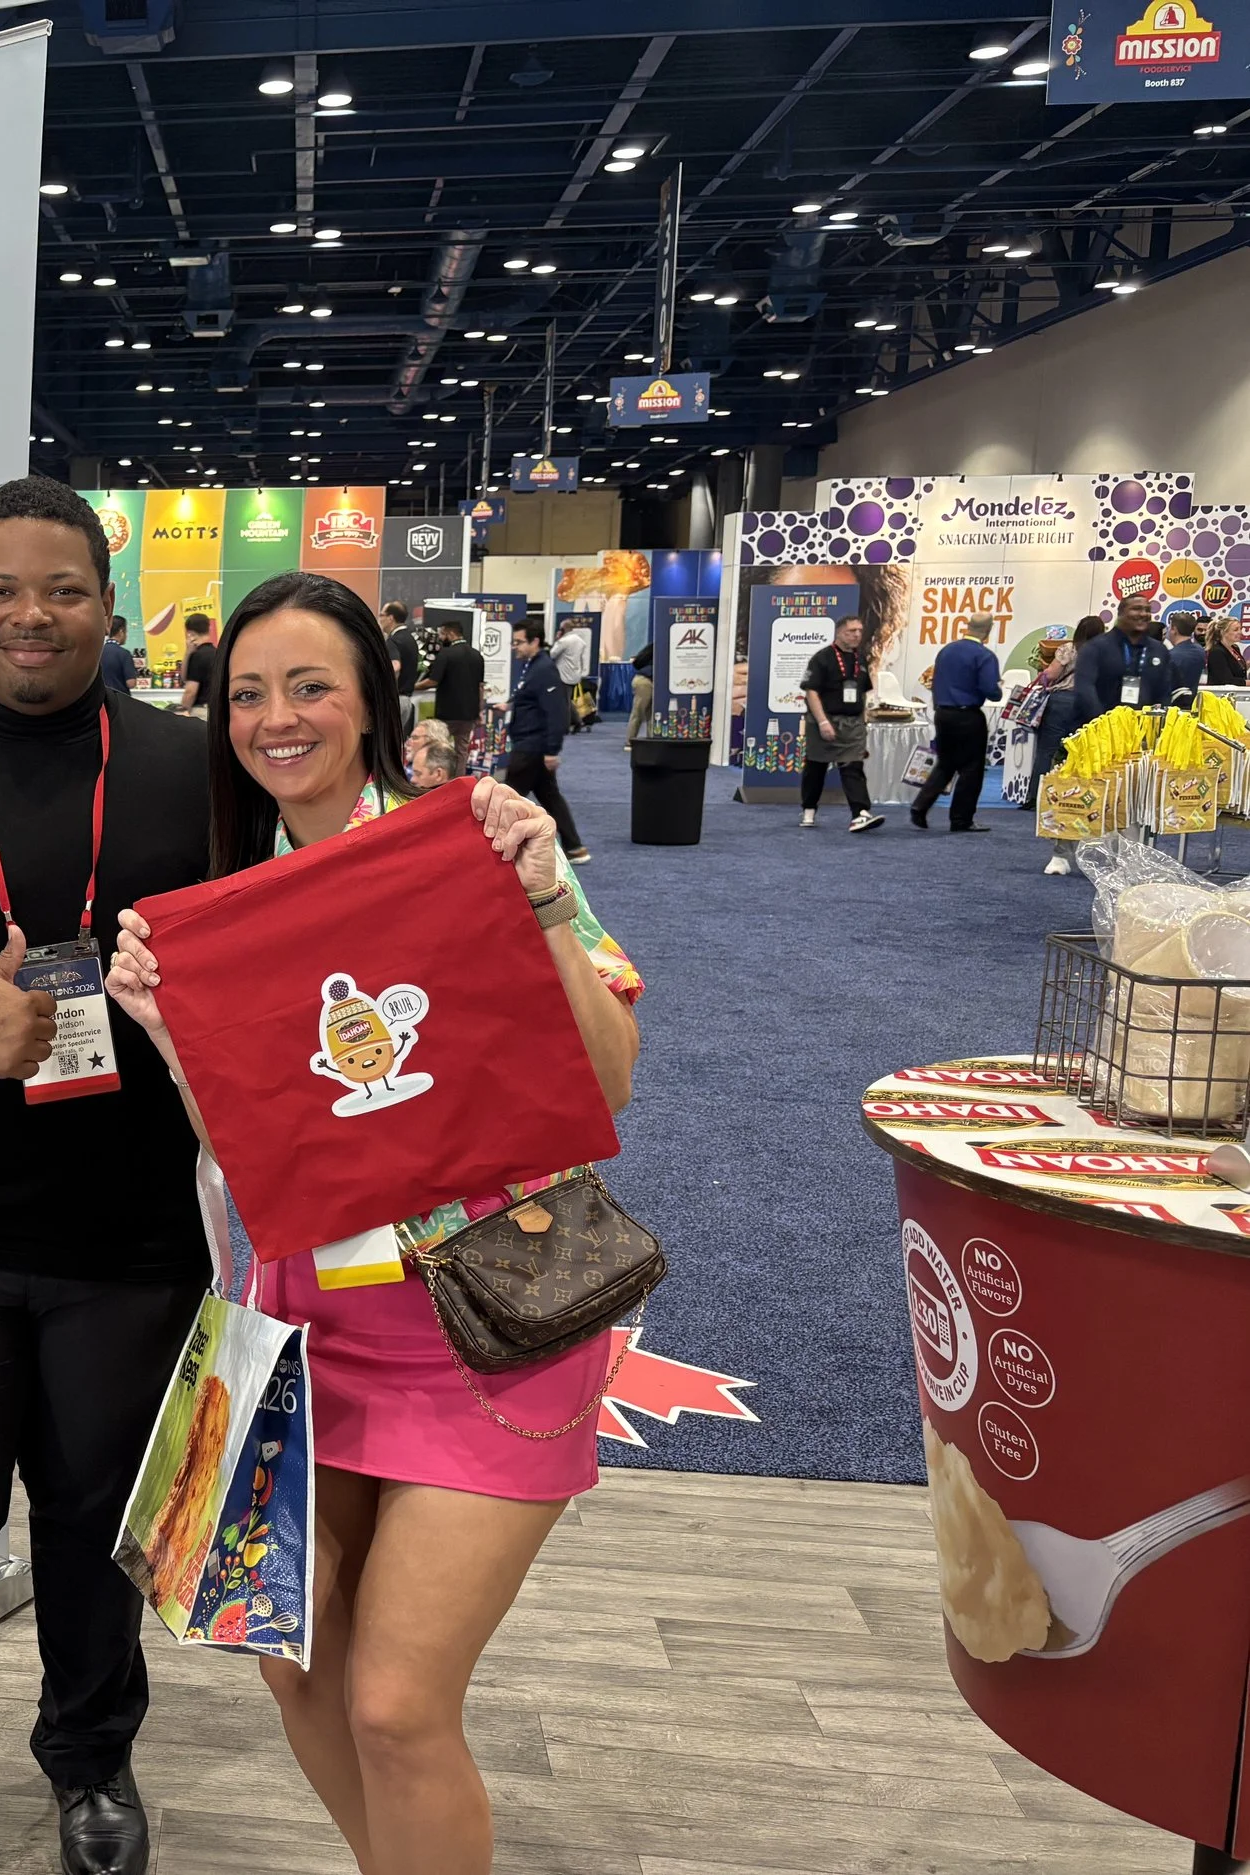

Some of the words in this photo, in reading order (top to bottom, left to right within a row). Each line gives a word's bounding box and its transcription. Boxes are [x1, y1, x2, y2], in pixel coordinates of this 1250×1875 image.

[1145, 78, 1169, 88] Booth
[1170, 78, 1186, 87] 837
[248, 520, 282, 529] GREEN
[331, 513, 361, 529] IBC
[986, 518, 1056, 527] International
[152, 527, 219, 540] MOTT'S
[240, 528, 289, 538] MOUNTAIN
[412, 533, 439, 546] REVV
[938, 532, 997, 546] SNACKING
[999, 532, 1036, 545] MADE
[1037, 532, 1074, 544] RIGHT
[925, 576, 965, 585] EMPOWER
[969, 576, 1000, 585] PEOPLE
[1004, 576, 1014, 584] TO
[1117, 573, 1152, 589] Nutter
[1121, 581, 1155, 598] Butter
[1205, 585, 1229, 600] RITZ
[771, 596, 809, 606] CULINARY
[811, 596, 838, 605] LUNCH
[922, 587, 1014, 613] SNACK
[184, 603, 213, 613] MOTT'S
[780, 606, 827, 616] EXPERIENCE
[677, 629, 707, 646] AK
[919, 615, 1013, 645] RIGT
[484, 634, 498, 643] EVV
[75, 983, 95, 993] 2026
[58, 1020, 85, 1030] aldson
[339, 1022, 370, 1041] IDAHOAN
[58, 1028, 102, 1040] Foodservice
[67, 1038, 95, 1047] Specialist
[974, 1247, 1002, 1271] NO
[908, 1227, 925, 1249] ADD
[926, 1241, 962, 1312] WATER
[966, 1264, 1016, 1293] Artificial
[971, 1280, 1013, 1306] Flavors
[1002, 1338, 1034, 1363] NO
[994, 1355, 1049, 1386] Artificial
[943, 1384, 954, 1402] IN
[954, 1362, 970, 1396] CUP
[1006, 1373, 1038, 1395] Dyes
[985, 1419, 1029, 1449] Gluten
[993, 1439, 1022, 1461] Free
